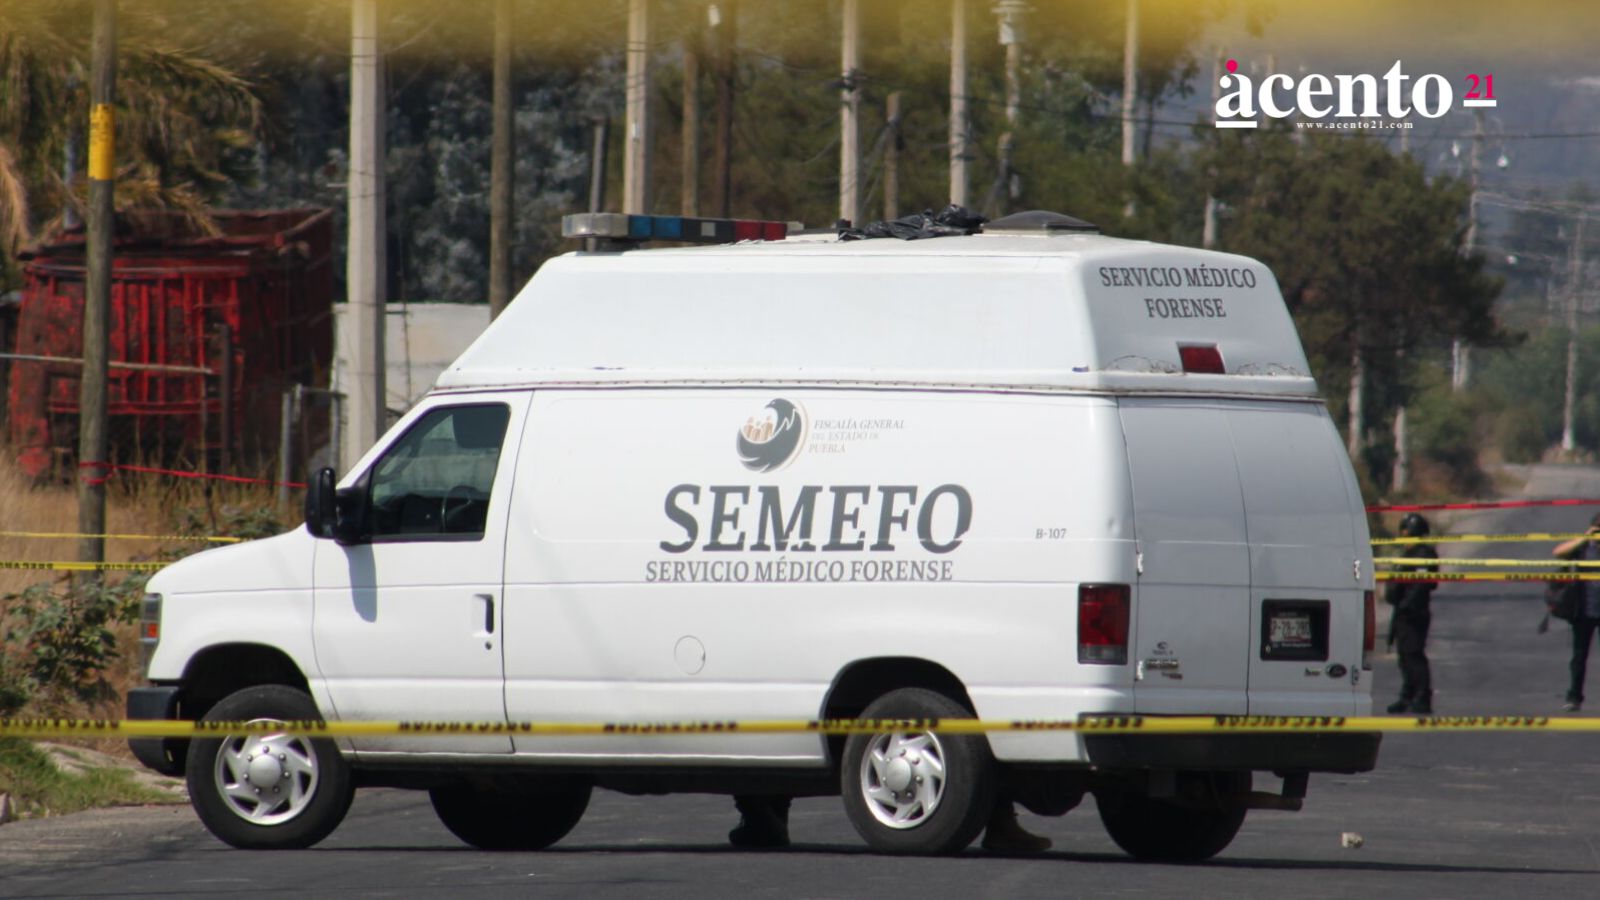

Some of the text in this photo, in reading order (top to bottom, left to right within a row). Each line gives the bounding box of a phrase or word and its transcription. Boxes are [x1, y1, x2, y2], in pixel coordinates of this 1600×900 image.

[1099, 264, 1256, 289] SERVICIO MÉDICO
[1144, 298, 1227, 319] FORENSE
[814, 418, 905, 430] FISCALÍA GENERAL
[828, 431, 868, 441] ESTADO
[808, 442, 846, 454] PUEBLA
[659, 483, 974, 555] SEMEFO
[1035, 527, 1068, 540] B-107
[645, 556, 954, 583] SERVICIO MÉDICO FORENSE
